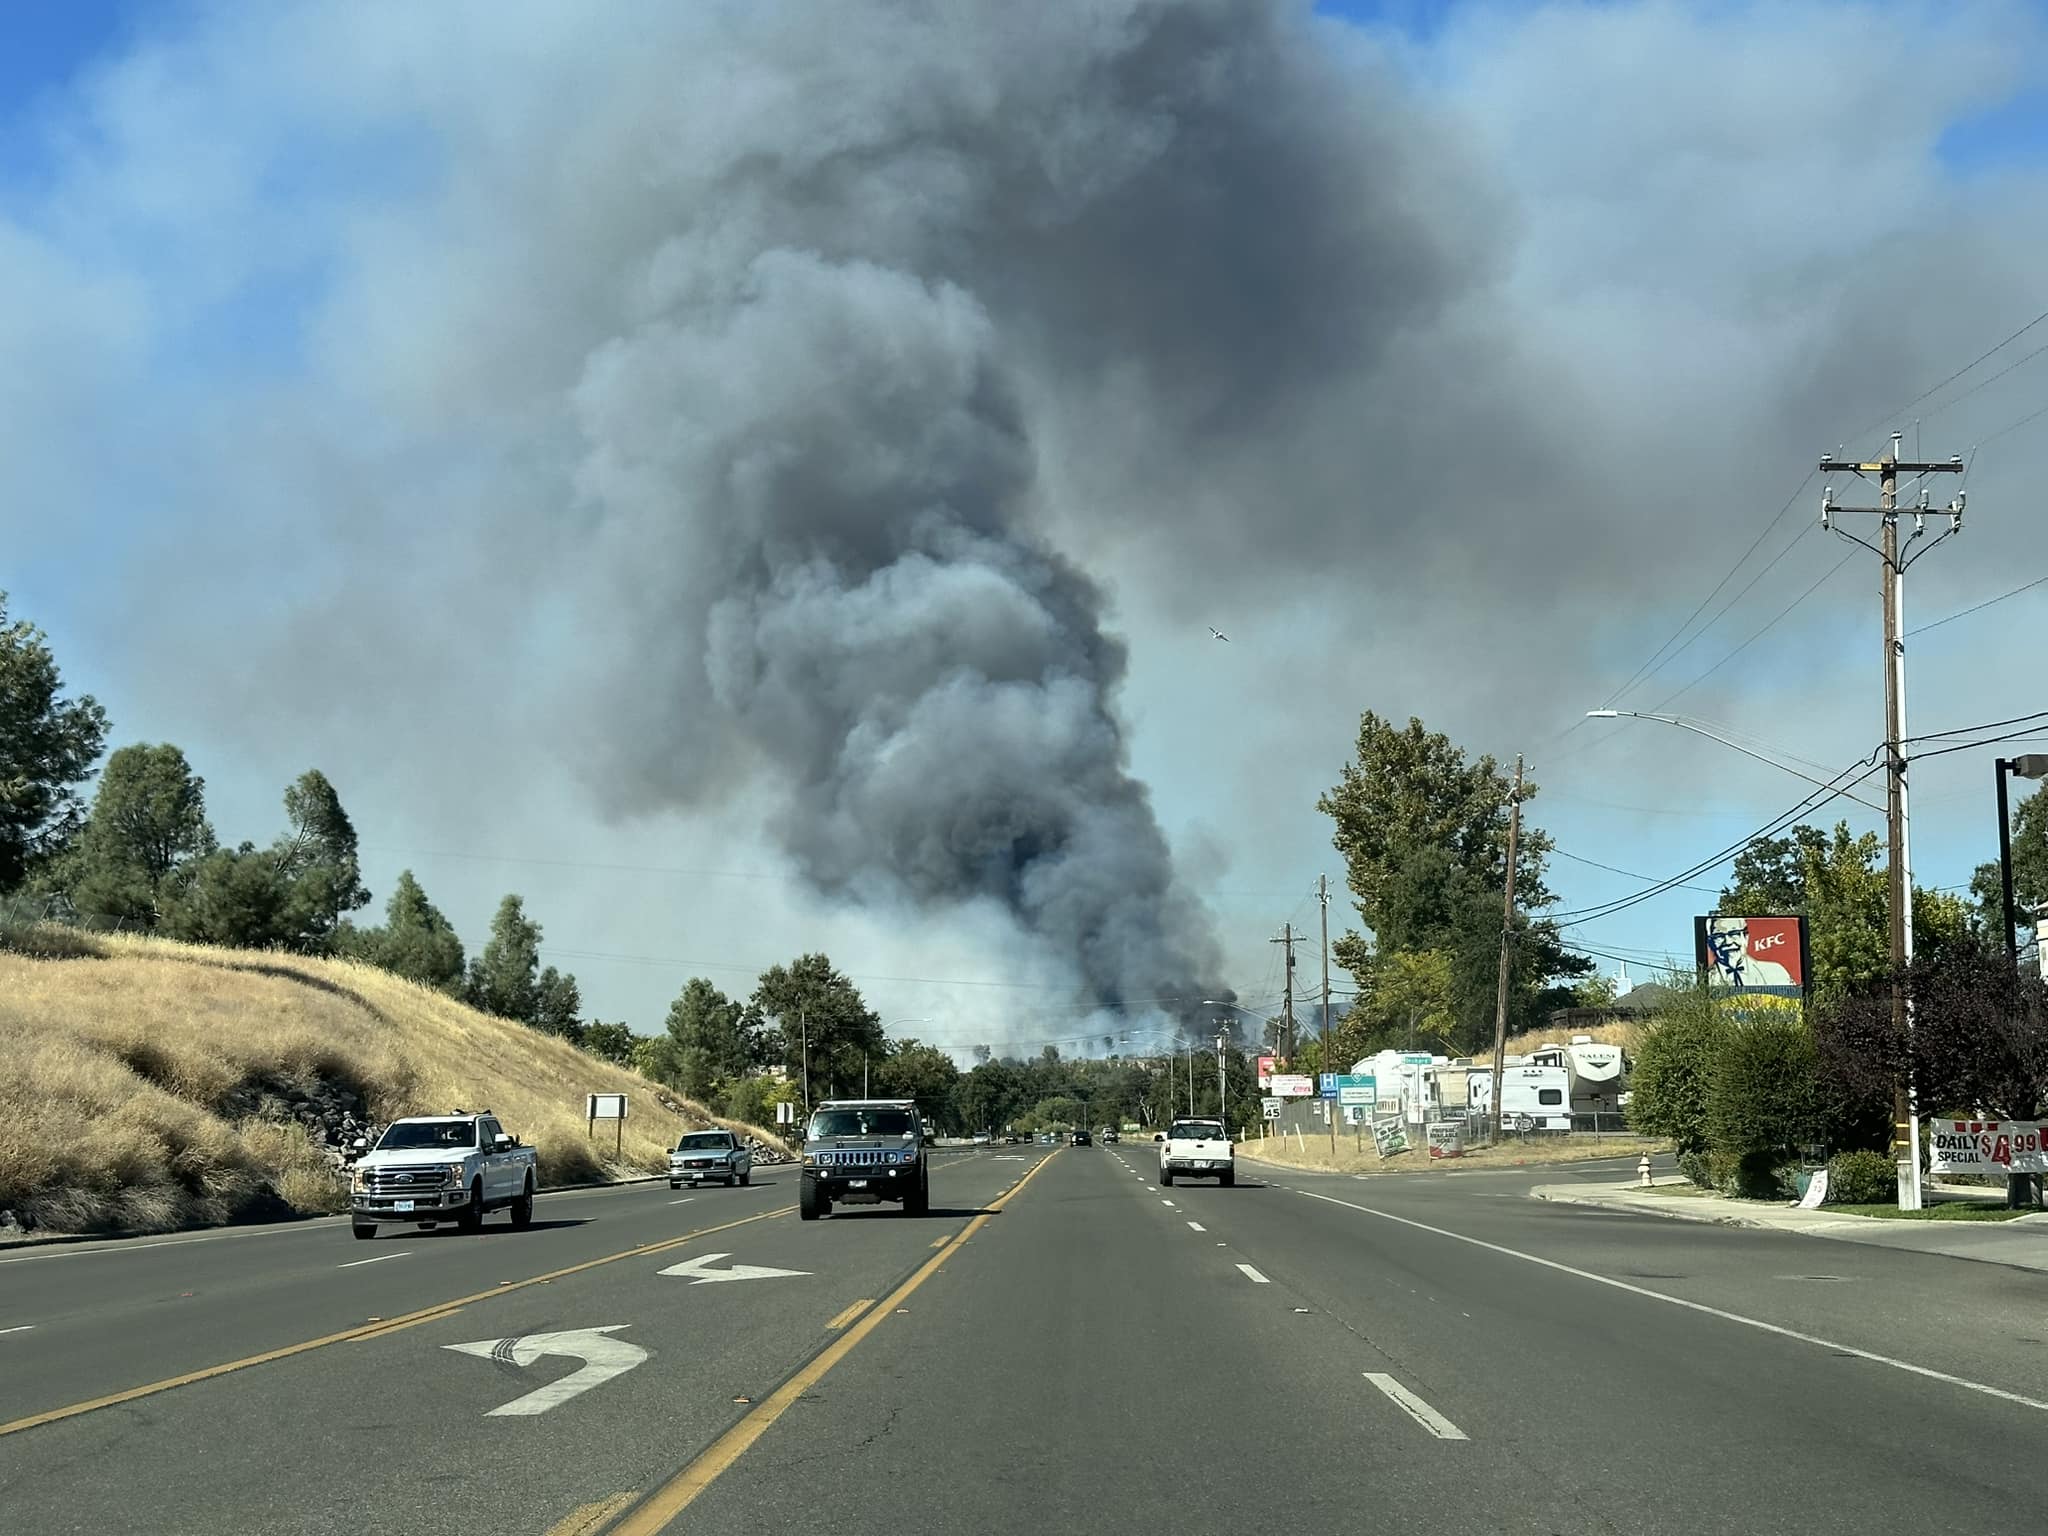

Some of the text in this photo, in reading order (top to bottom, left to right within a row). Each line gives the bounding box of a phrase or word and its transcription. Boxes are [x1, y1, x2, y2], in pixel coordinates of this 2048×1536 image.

[1754, 933, 1785, 952] KFC
[1323, 1074, 1334, 1089] H
[1265, 1108, 1280, 1118] 45
[1936, 1134, 1980, 1149] DAILY
[1937, 1151, 1981, 1163] SPECIAL
[1981, 1134, 2036, 1166] $4.99
